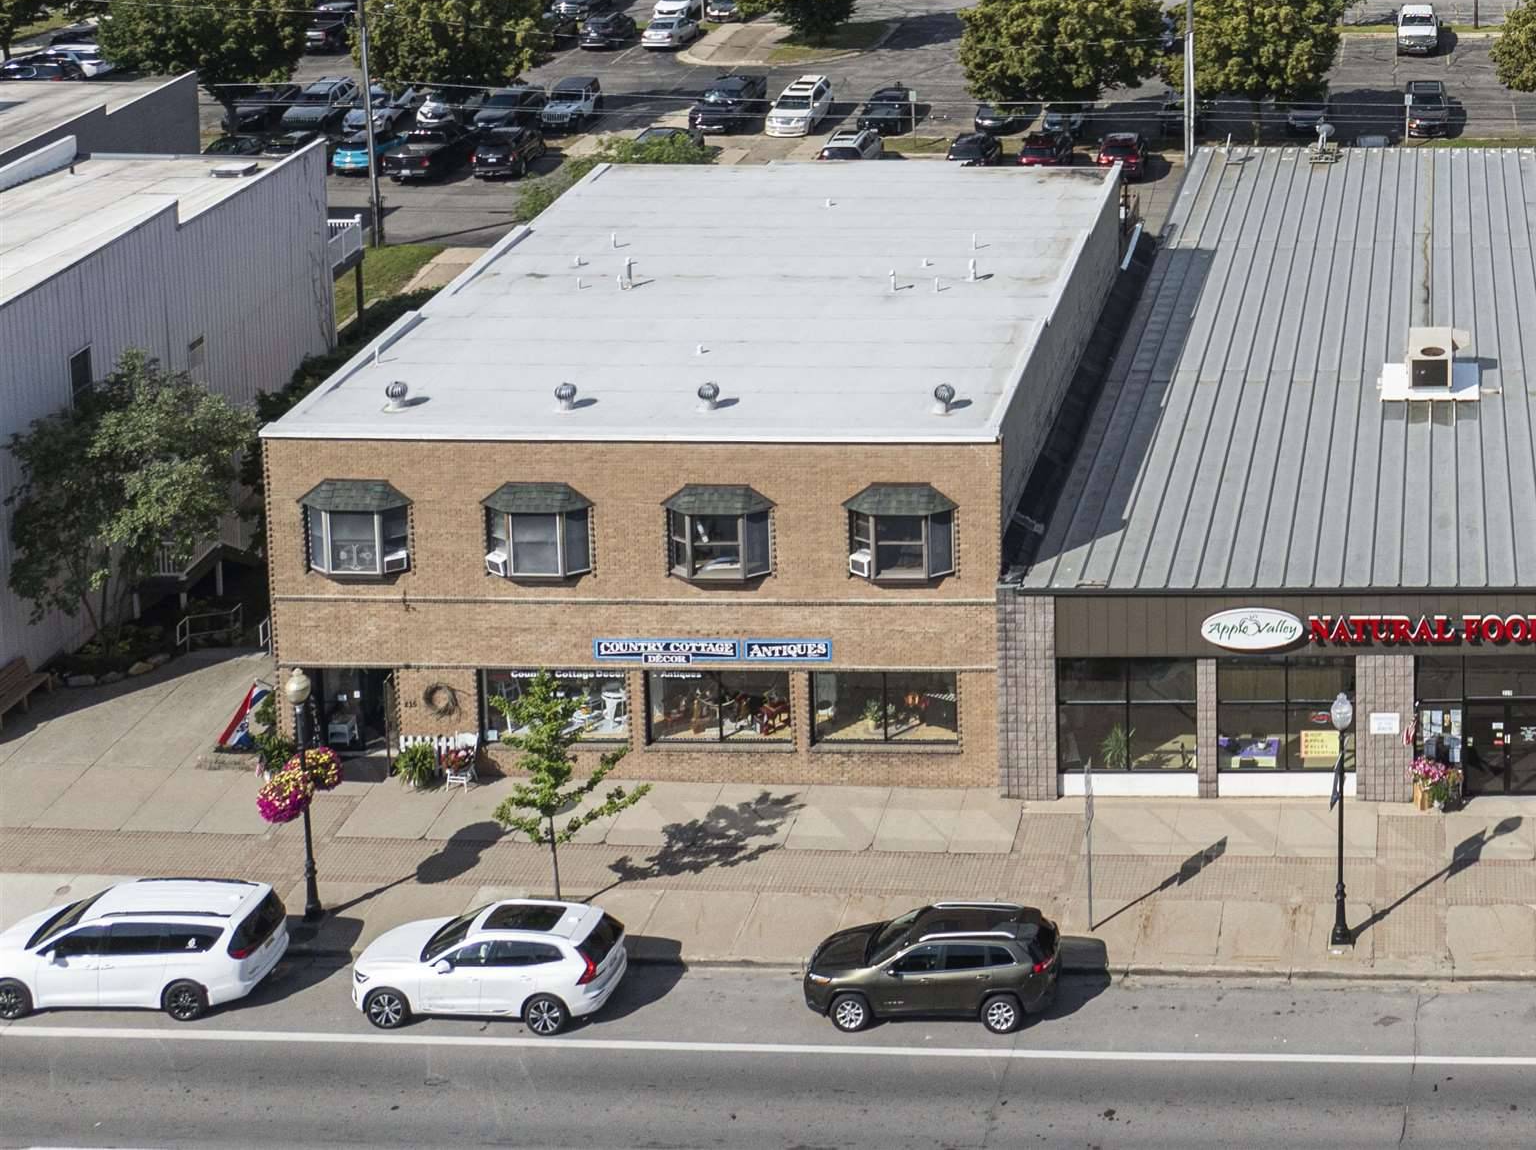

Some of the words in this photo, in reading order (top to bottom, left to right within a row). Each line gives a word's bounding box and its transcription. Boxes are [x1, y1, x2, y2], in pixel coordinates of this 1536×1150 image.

[1208, 620, 1249, 640] Apple
[1258, 619, 1297, 640] Valley
[1308, 614, 1455, 642] NATURAL
[600, 642, 667, 654] COUNTRY
[669, 642, 734, 655] COTTAGE
[749, 643, 826, 657] ANTIQUES
[511, 671, 551, 679] Couny
[660, 671, 702, 679] Antiques
